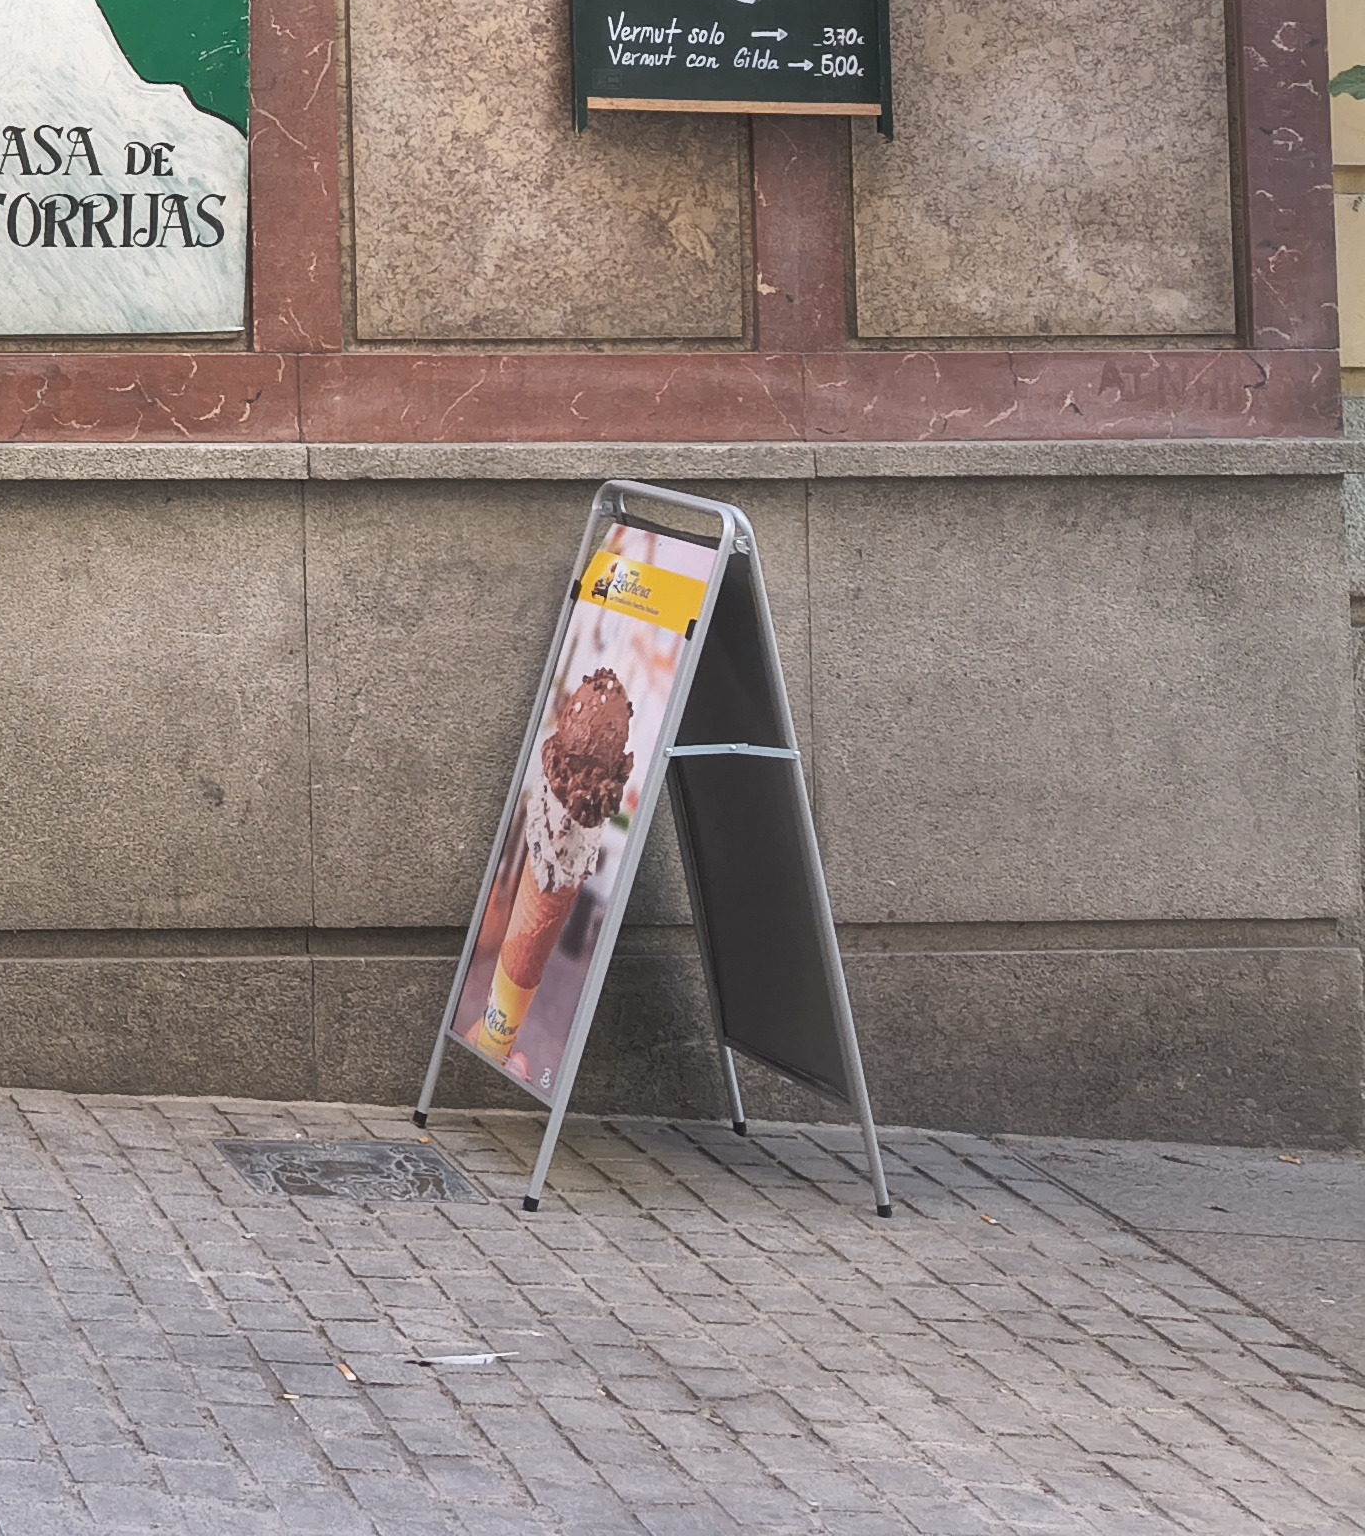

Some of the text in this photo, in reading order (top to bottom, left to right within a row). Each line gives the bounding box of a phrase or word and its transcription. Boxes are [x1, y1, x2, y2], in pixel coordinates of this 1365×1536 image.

[607, 11, 683, 44] Vermut
[687, 22, 725, 45] solo
[608, 44, 677, 66] Vermut
[685, 54, 720, 69] con
[733, 47, 779, 70] Gilda
[125, 141, 176, 177] DE
